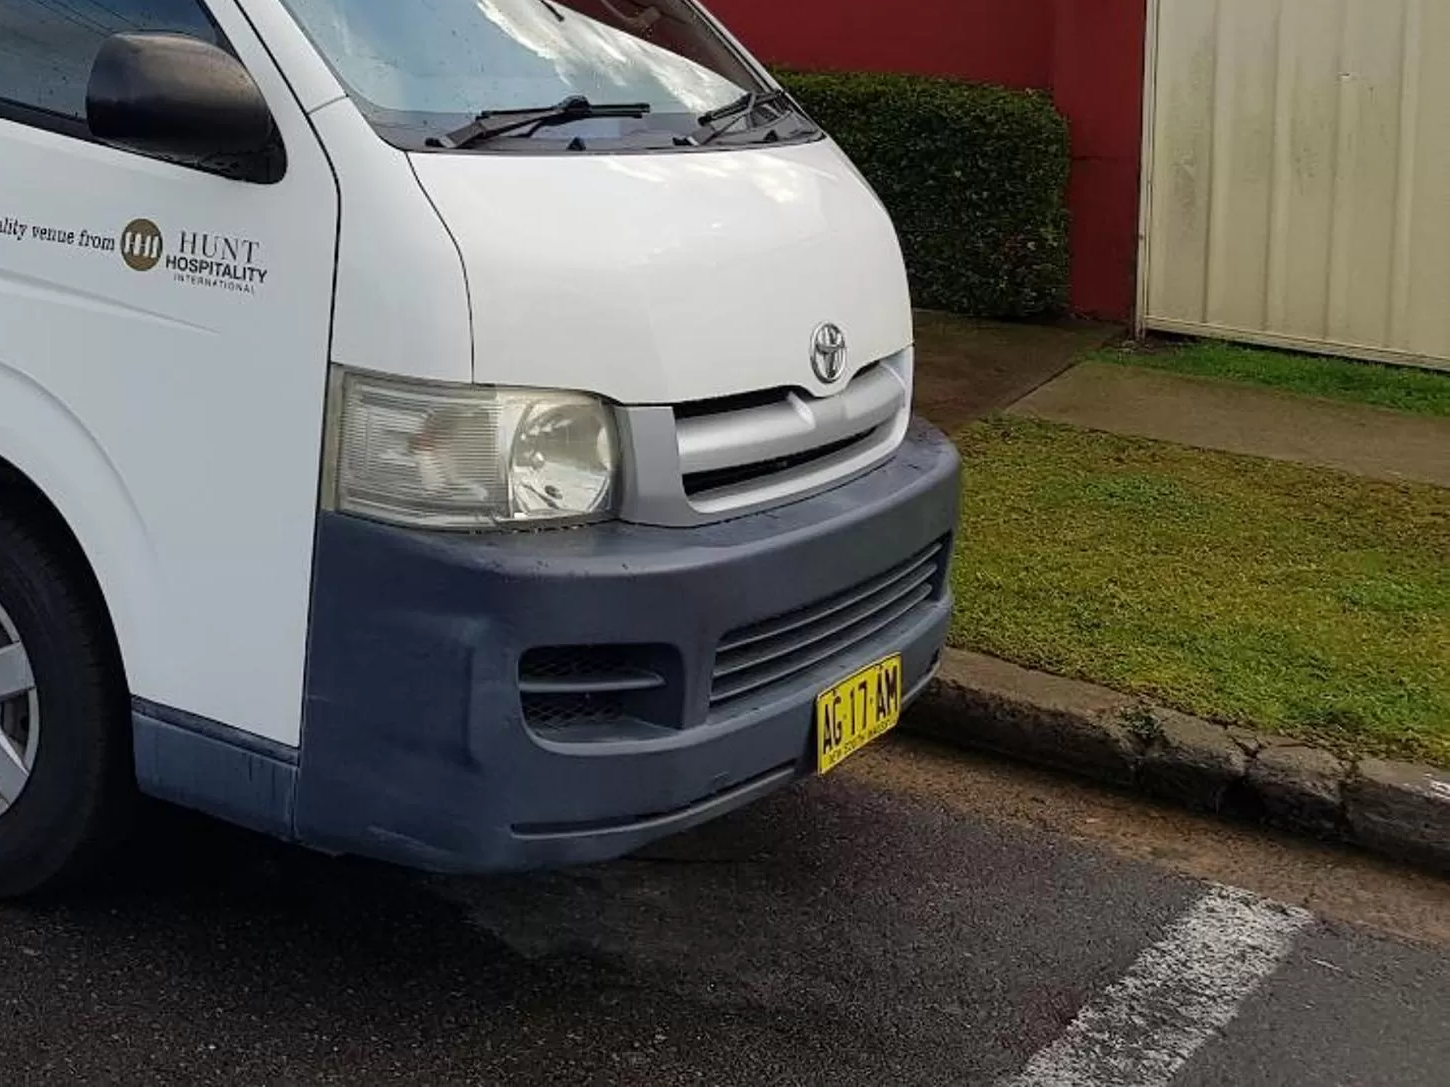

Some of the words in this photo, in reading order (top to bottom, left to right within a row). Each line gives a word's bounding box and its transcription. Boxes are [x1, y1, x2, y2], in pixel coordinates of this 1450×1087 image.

[32, 225, 75, 245] venue
[78, 229, 116, 252] from
[179, 231, 260, 264] HUNT
[165, 254, 268, 284] HOSPITALITY
[173, 273, 255, 294] INTERNATIONAL
